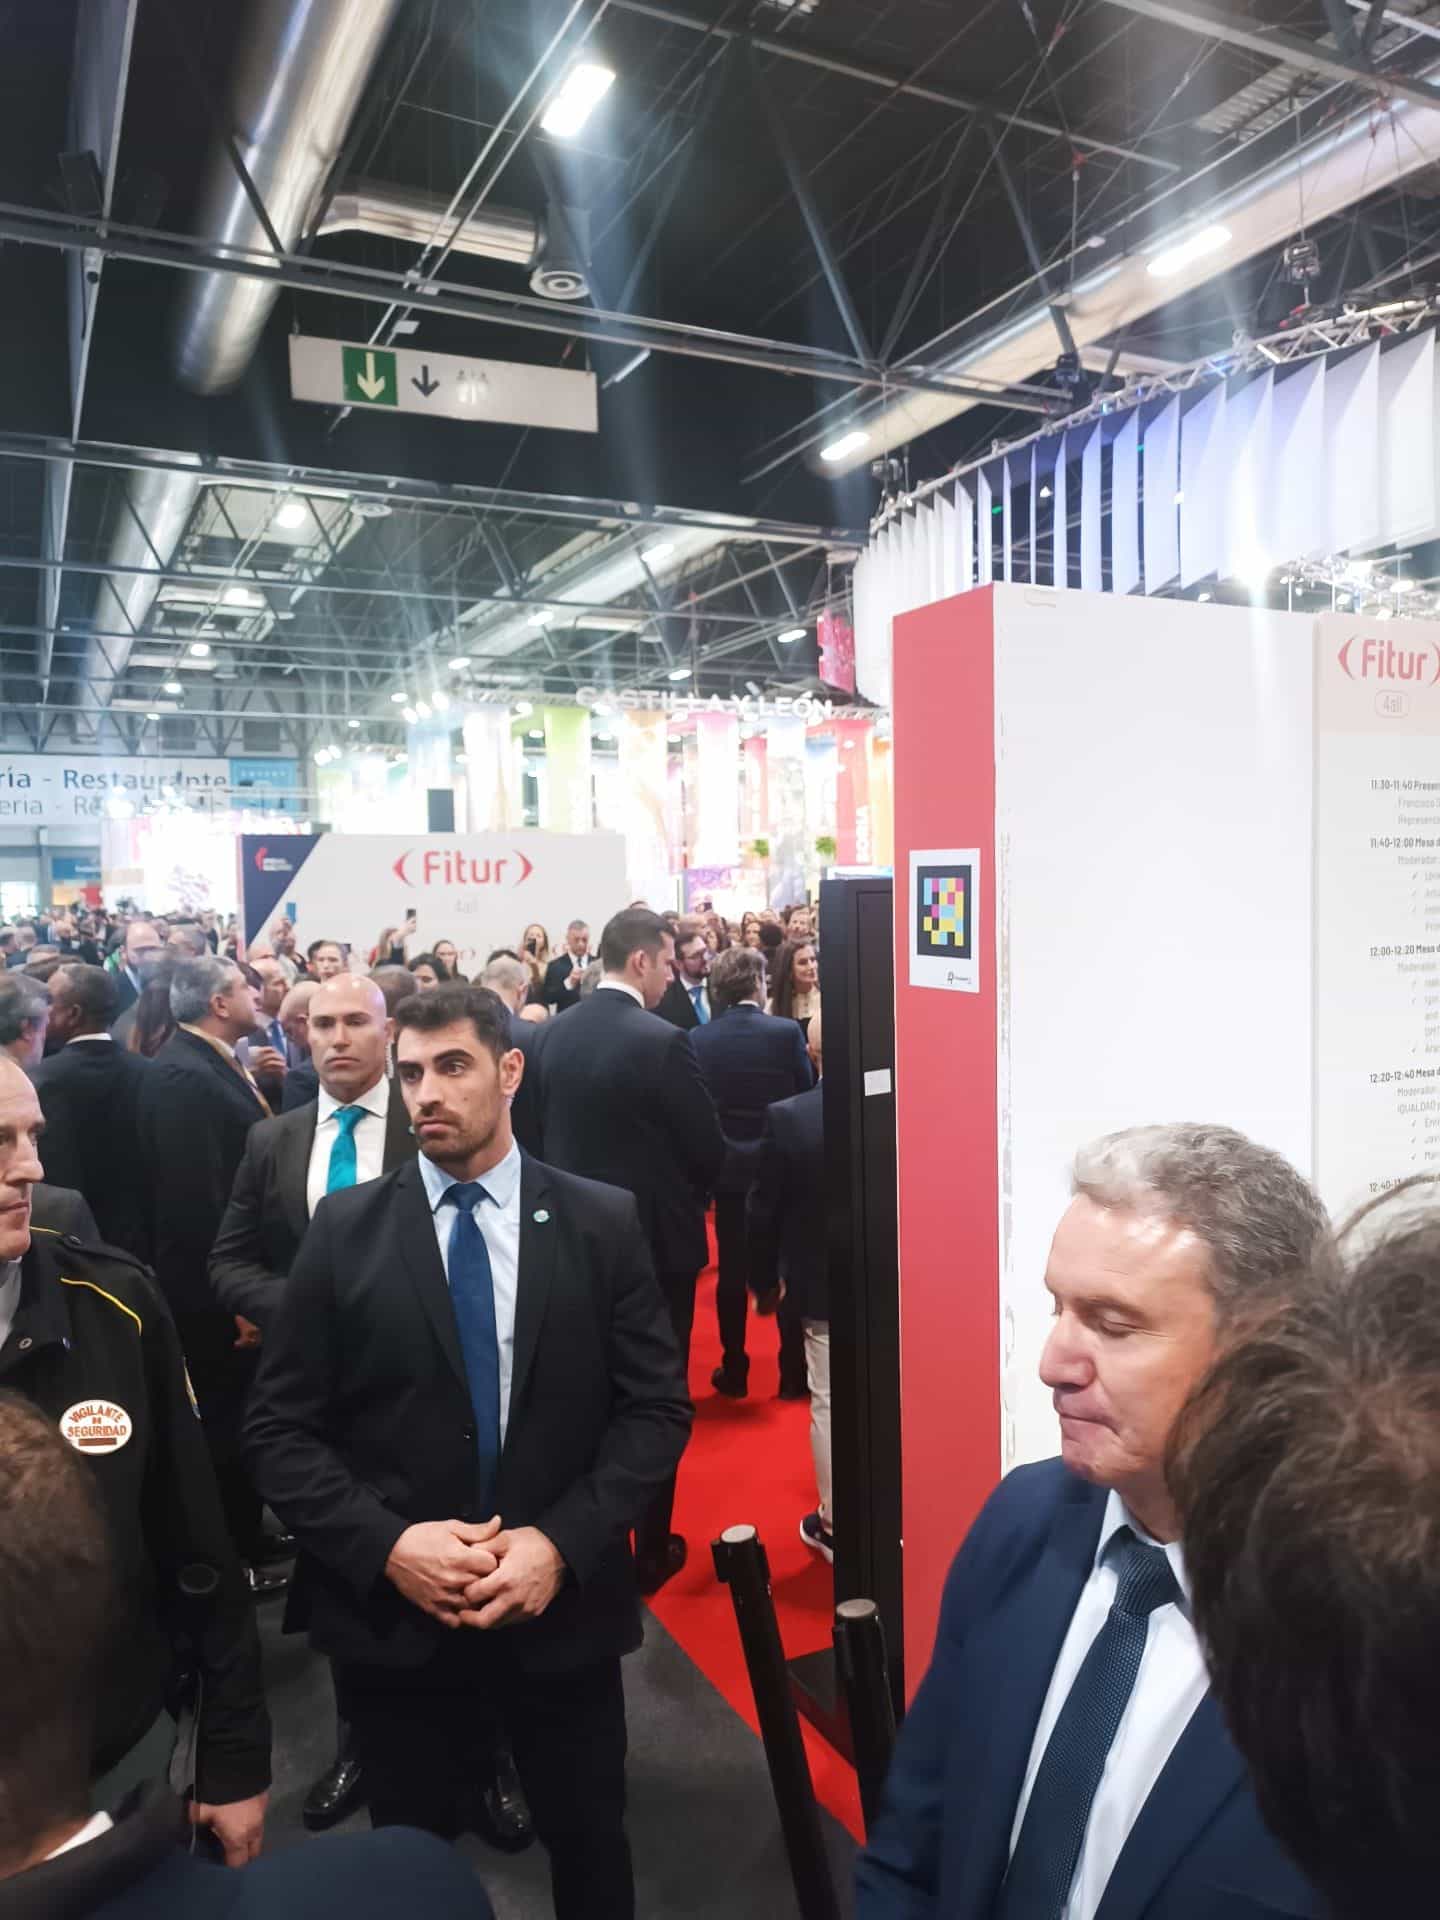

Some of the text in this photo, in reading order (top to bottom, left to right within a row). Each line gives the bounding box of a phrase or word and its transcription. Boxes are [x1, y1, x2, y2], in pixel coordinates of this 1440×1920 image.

[1416, 1067, 1435, 1078] Mesa
[68, 1405, 124, 1423] VIGILANTE
[67, 1425, 127, 1437] SEGURIDAD
